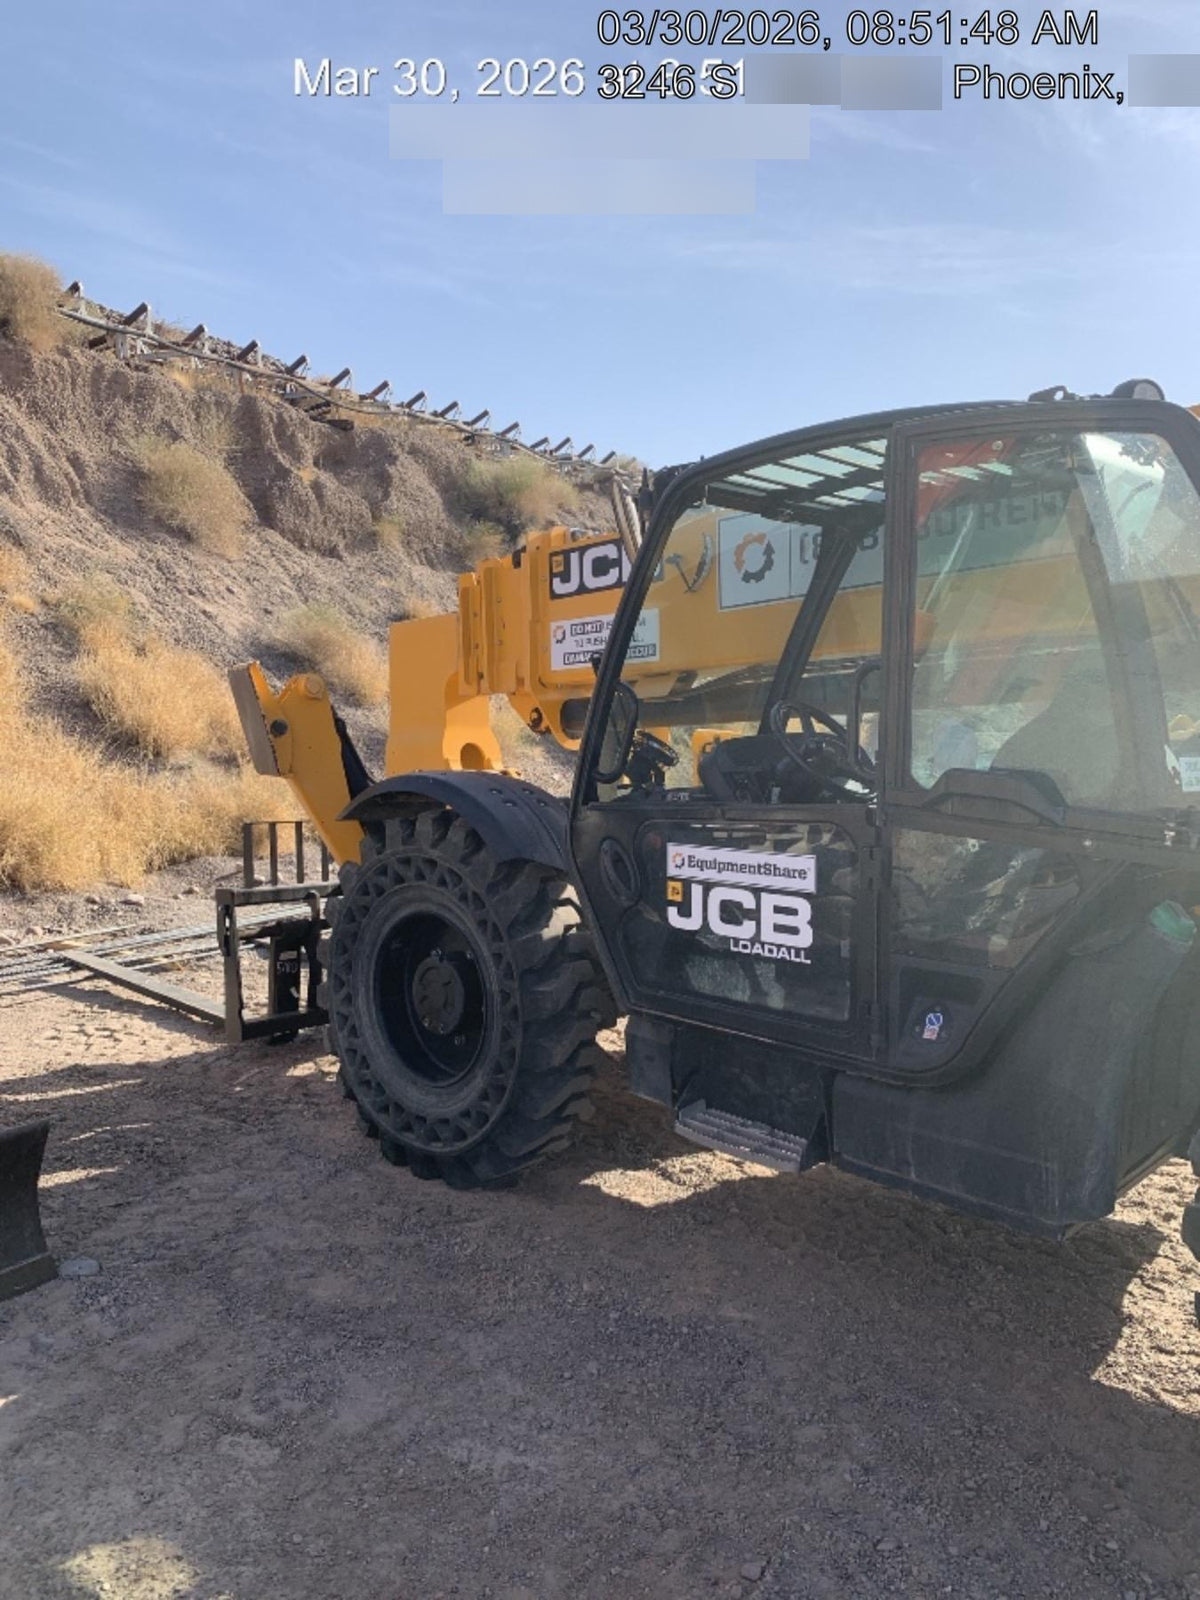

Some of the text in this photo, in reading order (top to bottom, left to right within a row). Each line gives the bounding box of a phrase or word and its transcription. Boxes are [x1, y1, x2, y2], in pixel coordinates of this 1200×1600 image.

[687, 854, 808, 881] EquipmentShare
[667, 883, 814, 948] JCB
[730, 938, 812, 965] LOADALL
